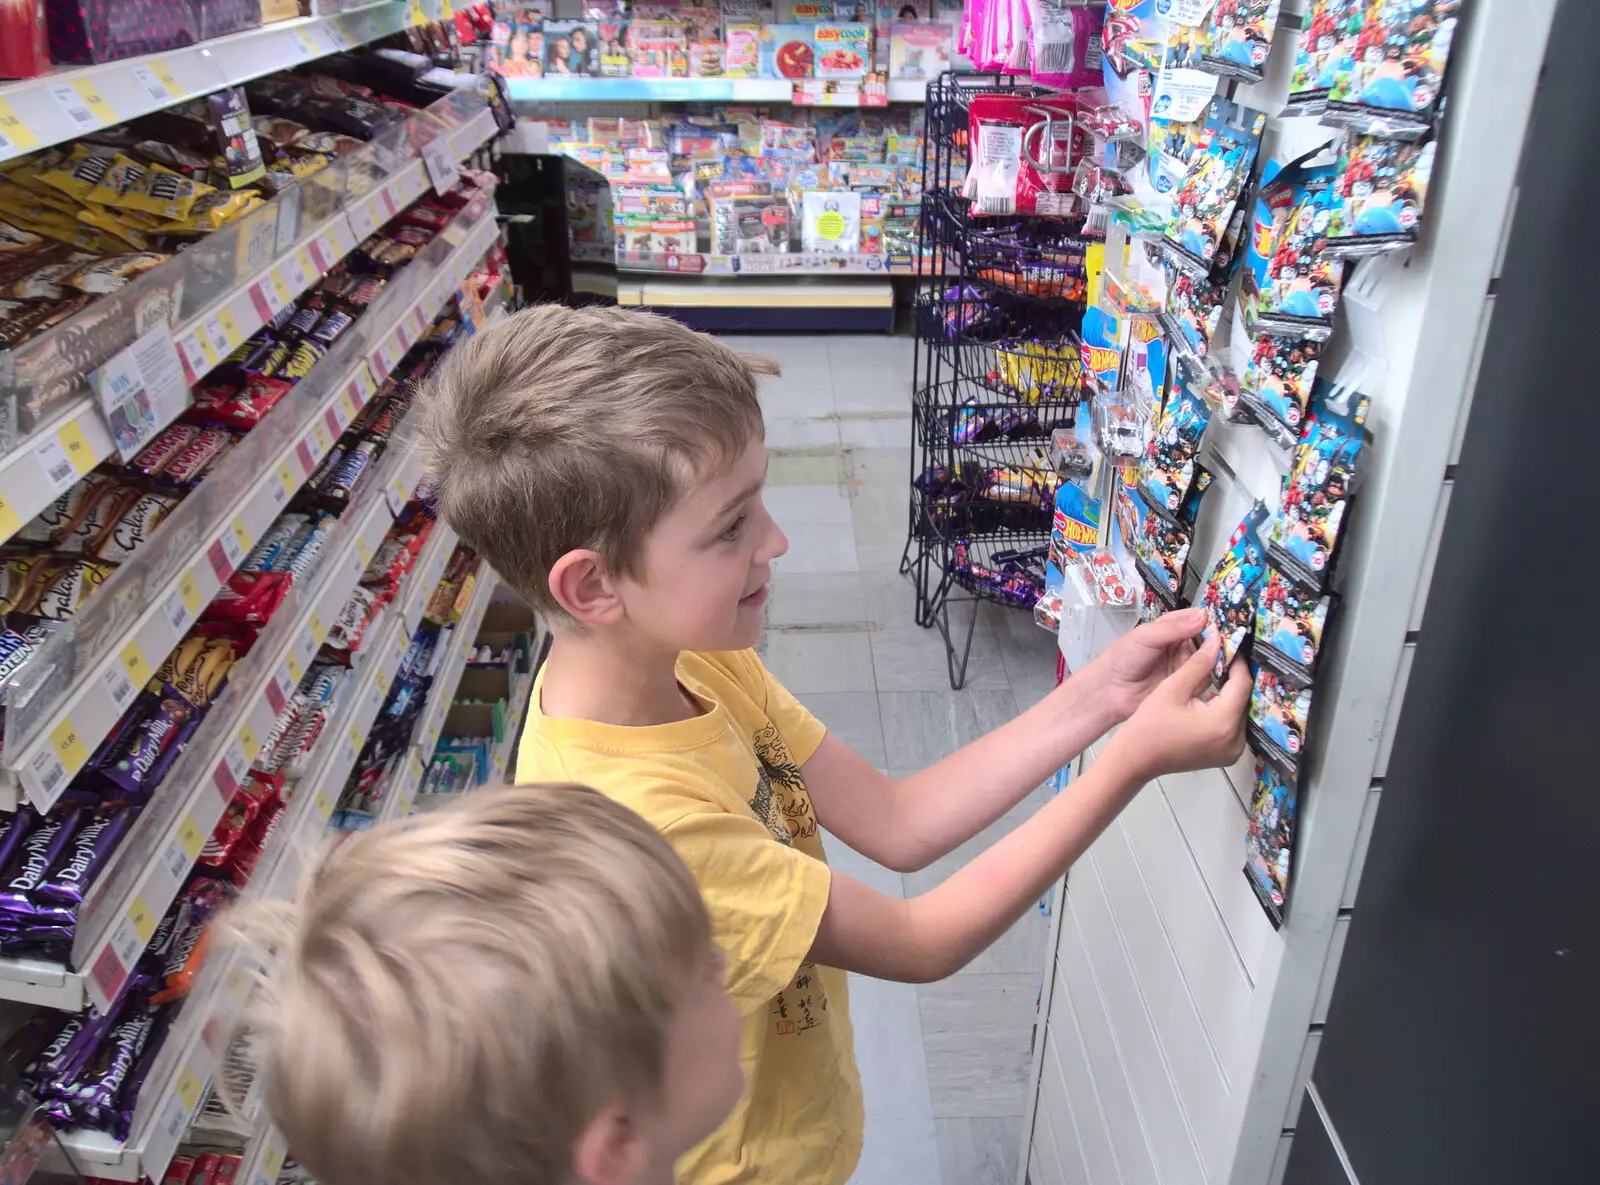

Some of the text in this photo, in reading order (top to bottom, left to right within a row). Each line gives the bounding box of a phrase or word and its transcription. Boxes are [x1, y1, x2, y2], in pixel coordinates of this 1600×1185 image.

[8, 821, 62, 890] Dairy Milk
[56, 818, 111, 881] Dairy Milk
[41, 1019, 83, 1058] Dairy
[100, 1018, 146, 1092] Dairy Milk
